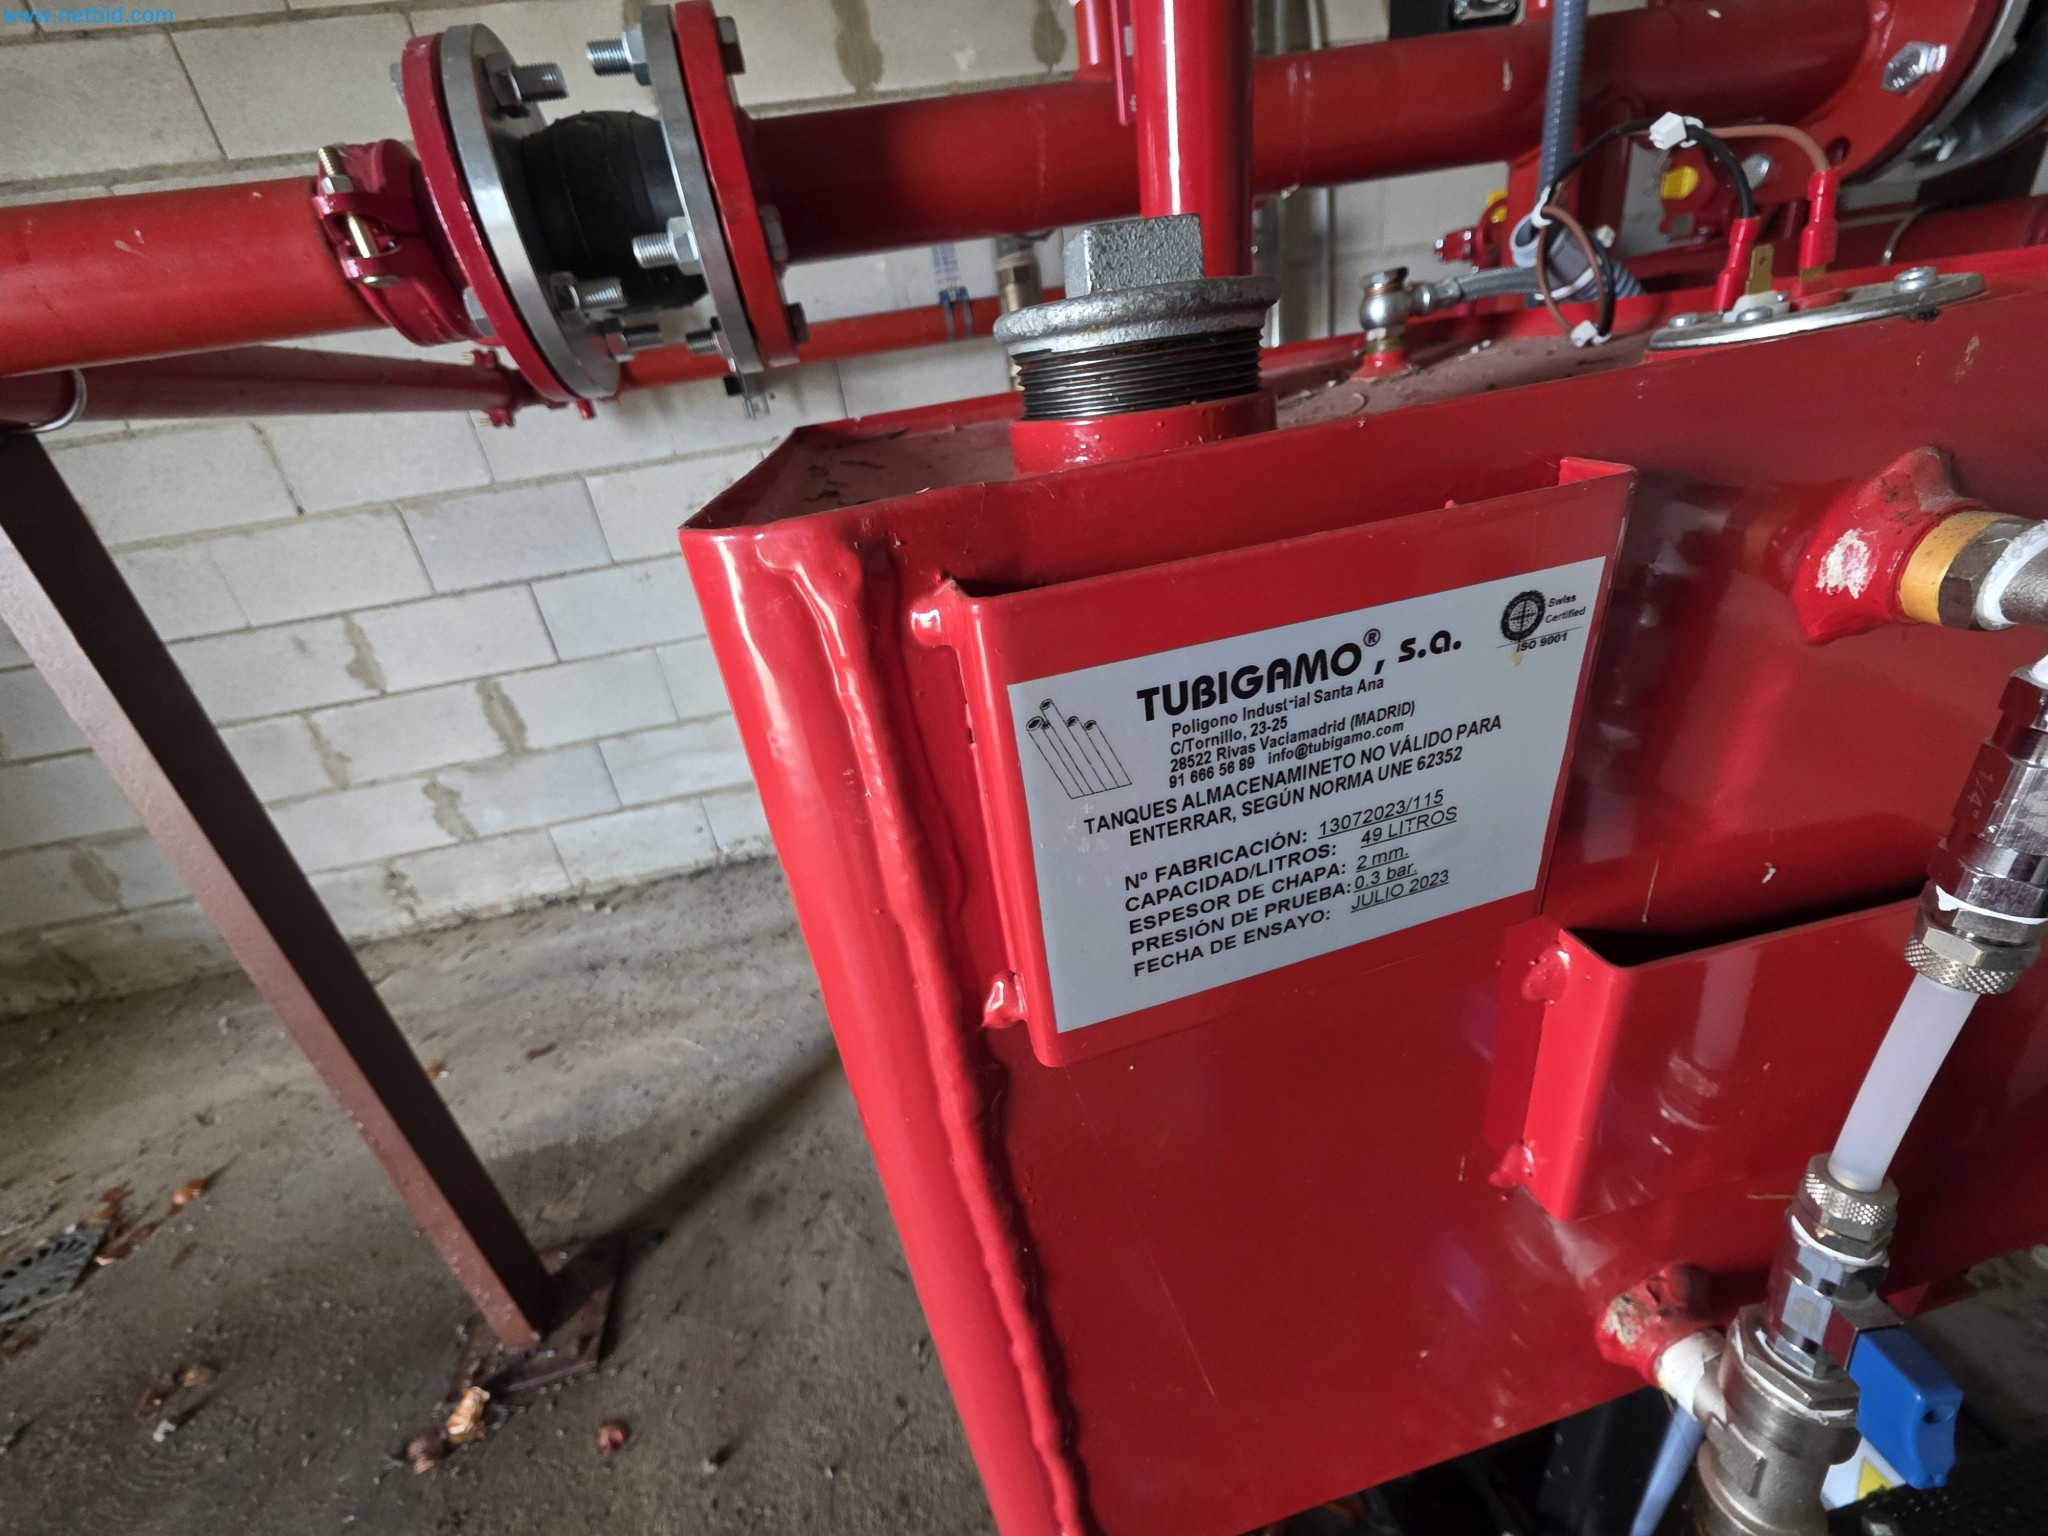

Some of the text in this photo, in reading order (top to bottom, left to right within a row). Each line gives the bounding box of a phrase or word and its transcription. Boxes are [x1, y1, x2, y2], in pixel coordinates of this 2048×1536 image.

[1545, 606, 1587, 623] Certified
[1547, 595, 1577, 608] Swiss
[1398, 630, 1462, 663] s.a.
[1516, 632, 1568, 653] ISO 9001
[1314, 684, 1353, 704] Santa
[1356, 678, 1385, 695] Ana
[1169, 722, 1404, 789] 91 666 56 89 info@tubigamo.com
[1170, 716, 1288, 756] C/Tornillo, 23-25
[1170, 700, 1416, 773] 28522 Rivas Vaciamadrid (MADRID)
[1083, 715, 1502, 835] TANQUES ALMACENAMINETO NO VÁLIDO PARA
[1129, 746, 1464, 847] ENTERRAR, SEGÚN NORMA UNE 62352
[1125, 806, 1458, 912] CAPACIDAD/LITROS: 49 LITROS
[1155, 830, 1308, 883] FABRICACIÓN:
[1318, 789, 1444, 838] 13072023/115
[1129, 847, 1410, 935] ESPESOR DE CHAPA: 2 mm.
[1131, 862, 1418, 956] PRESIÓN DE PRUEBA: 0.3 bar.
[1133, 869, 1450, 977] FECHA DE ENSAYO: JULIO 2023
